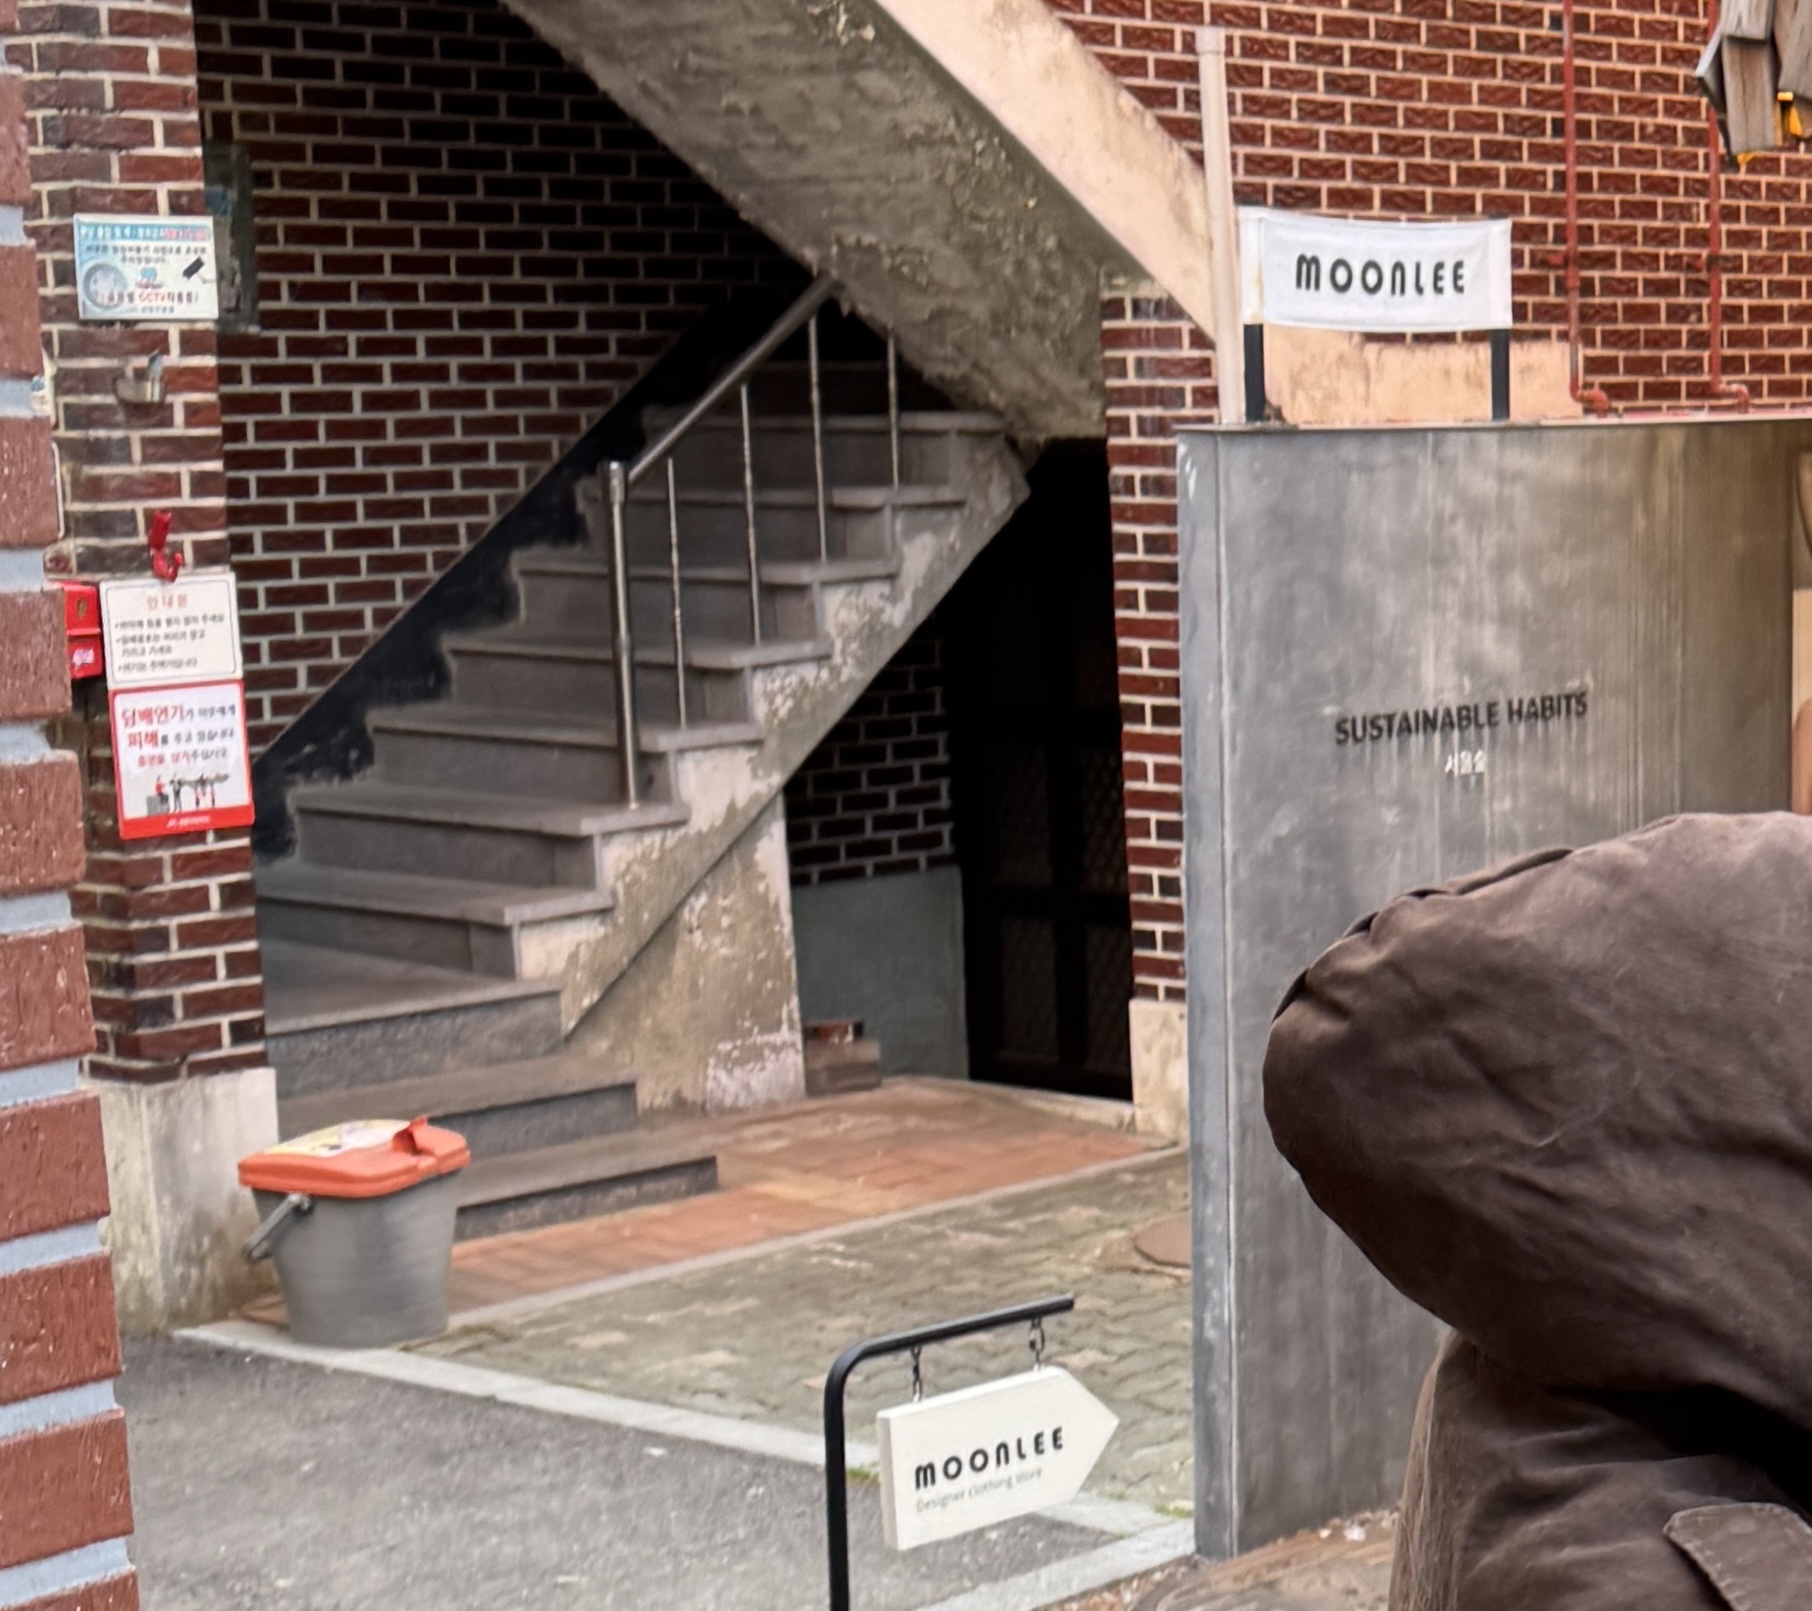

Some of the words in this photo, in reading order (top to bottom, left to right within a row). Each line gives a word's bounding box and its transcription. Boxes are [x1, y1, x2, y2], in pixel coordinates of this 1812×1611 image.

[1296, 253, 1464, 296] MOONLEE
[1334, 701, 1500, 746] SUSTAINABLE
[1507, 692, 1588, 724] HABITS
[915, 1426, 1063, 1491] MOONLEE
